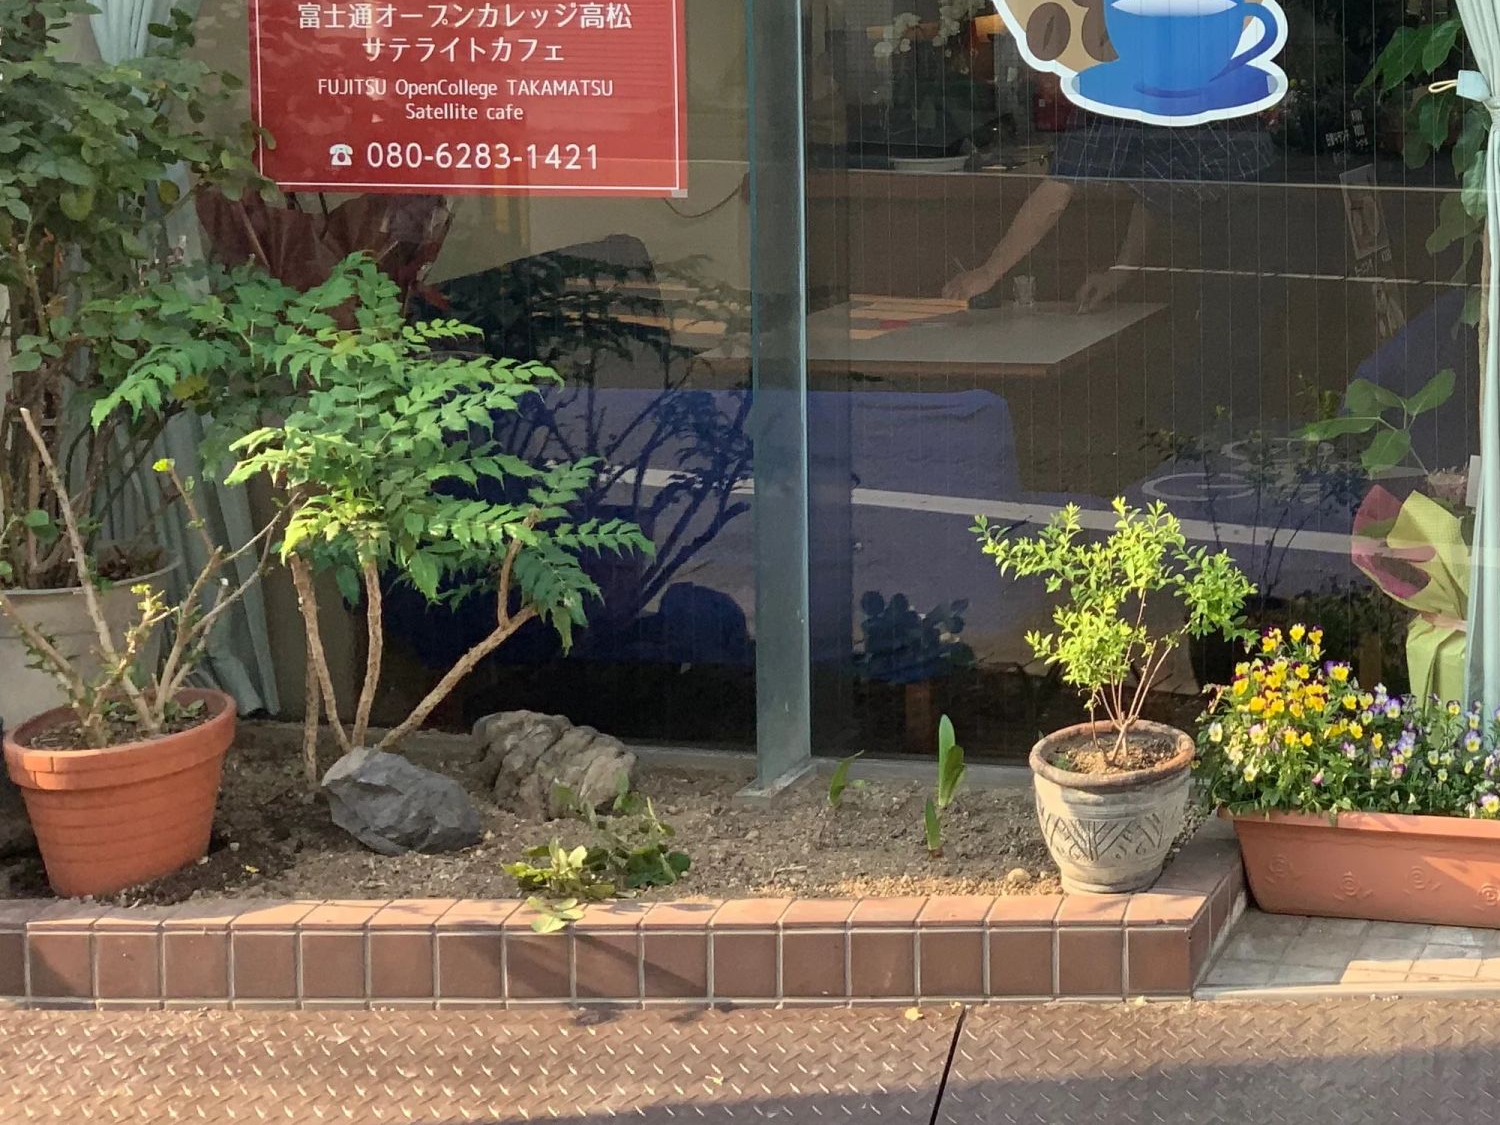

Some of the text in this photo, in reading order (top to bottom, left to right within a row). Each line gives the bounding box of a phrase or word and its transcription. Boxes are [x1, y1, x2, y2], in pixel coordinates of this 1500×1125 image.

[298, 1, 633, 30] 富士通オープンカレッジ高松
[362, 36, 565, 63] サテライトカフェ
[318, 79, 613, 98] FUJITSU OpenCollege TAKAMATSU
[405, 103, 524, 121] Satellite cafe
[367, 142, 599, 171] 080-6283-1421
